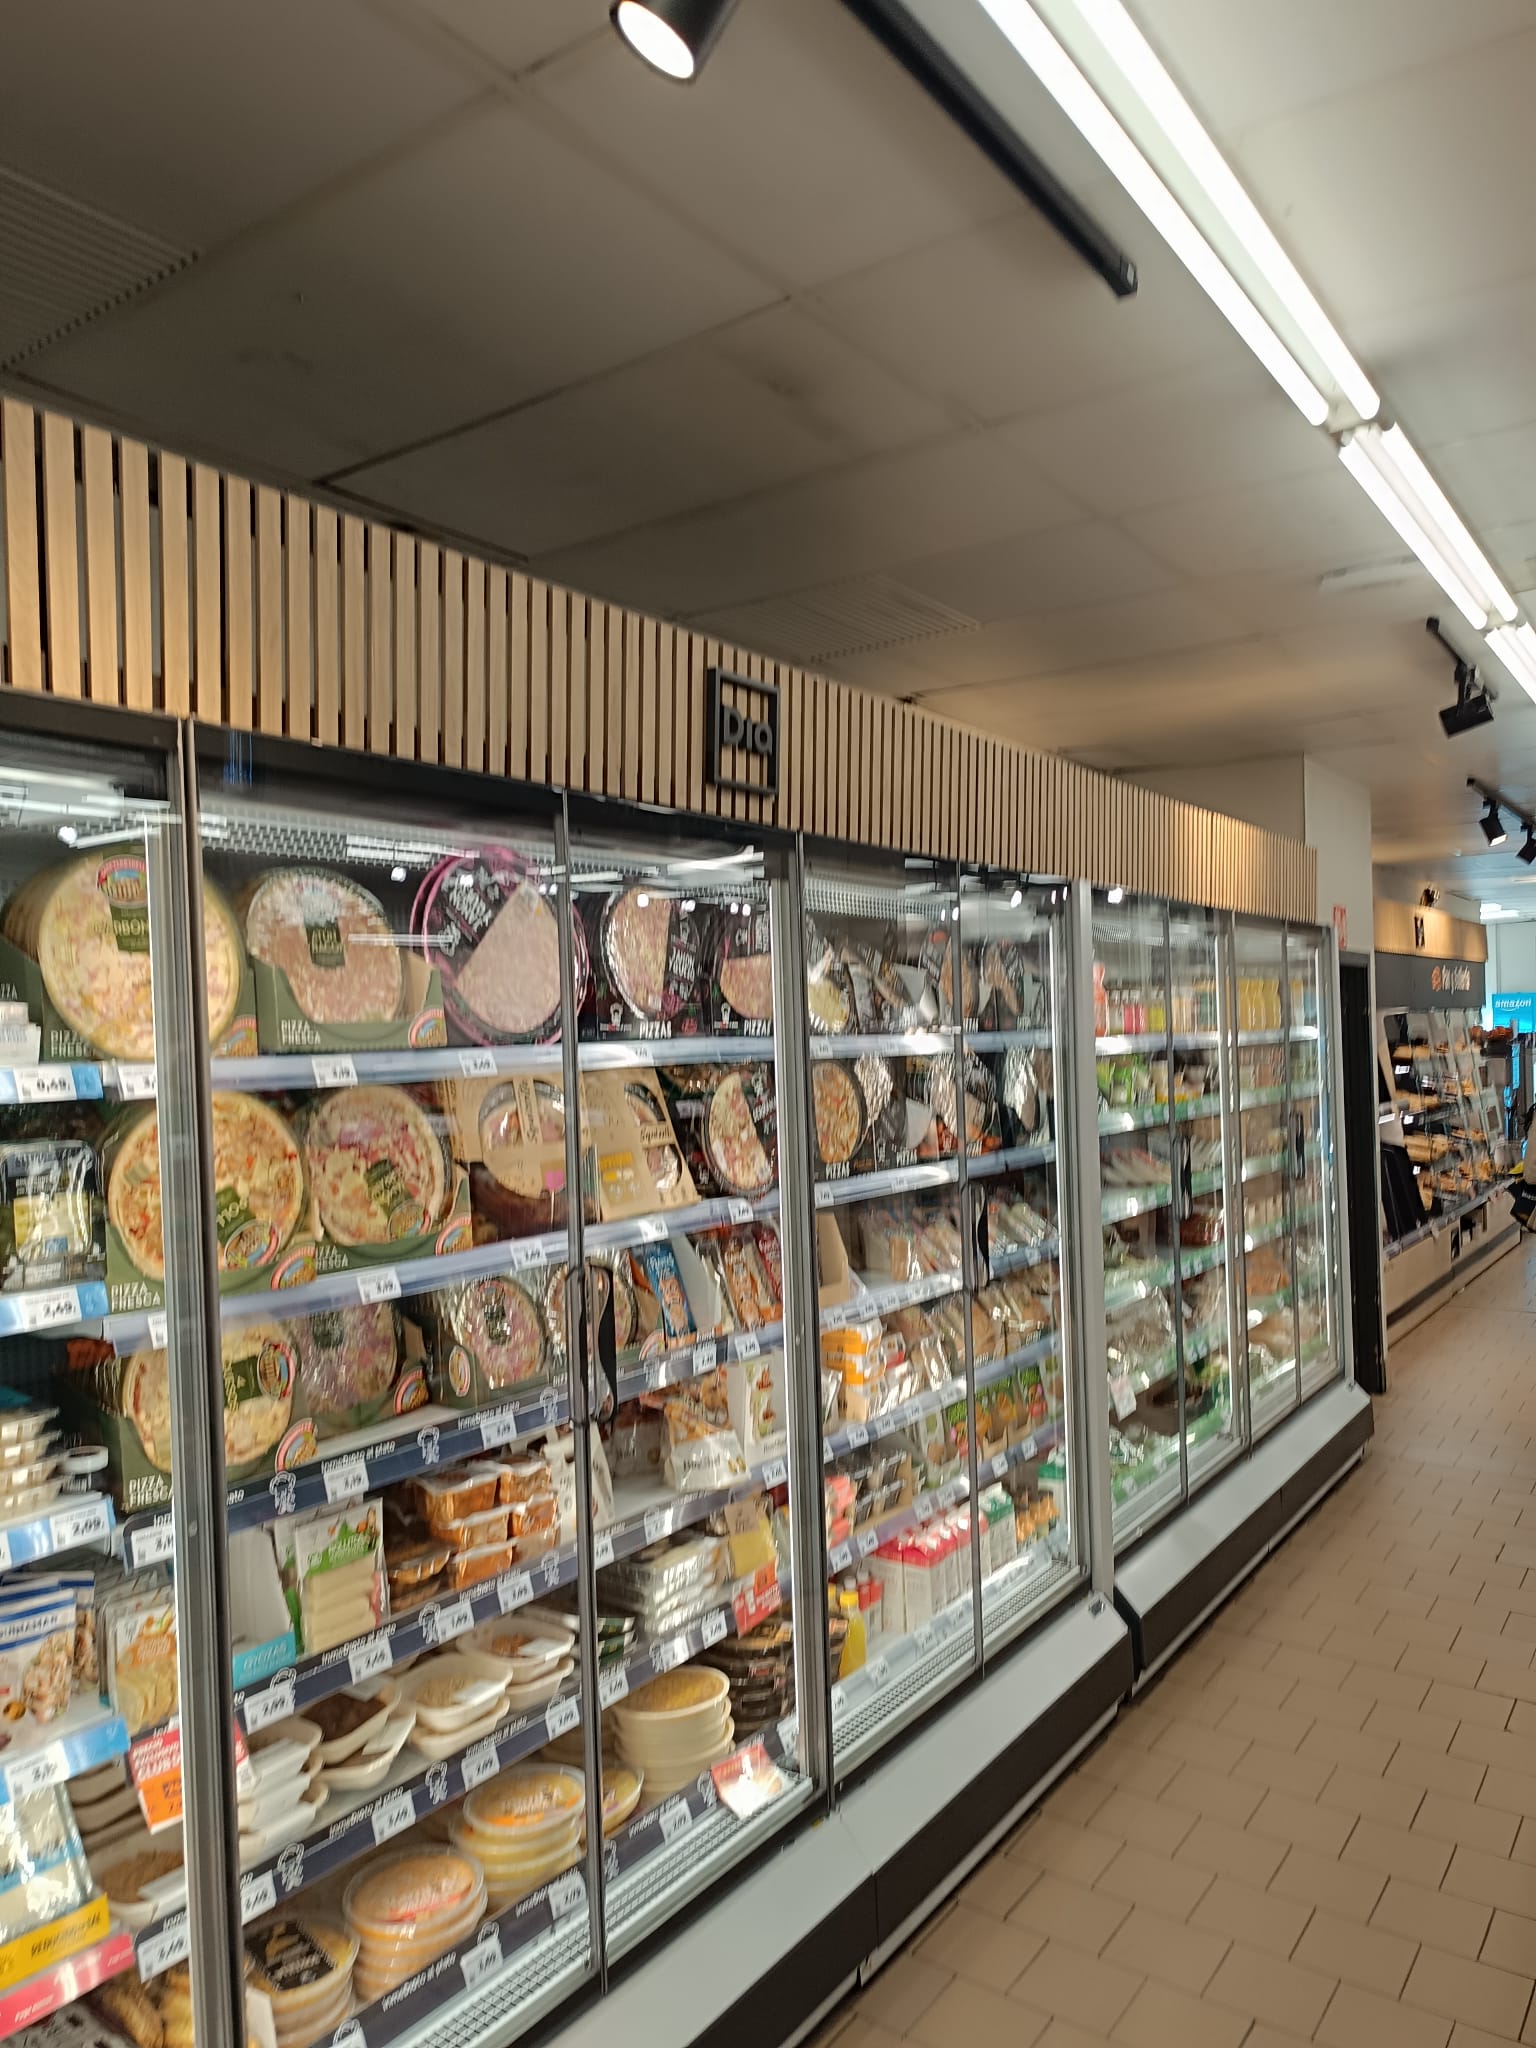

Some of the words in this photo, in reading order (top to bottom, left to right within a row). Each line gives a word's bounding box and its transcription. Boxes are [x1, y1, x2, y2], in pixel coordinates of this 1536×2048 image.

[724, 706, 773, 756] Dia
[1495, 998, 1531, 1009] amazon
[111, 1280, 148, 1297] PIZZA
[111, 1291, 162, 1312] FRESCA
[129, 1474, 164, 1492] PIZZA
